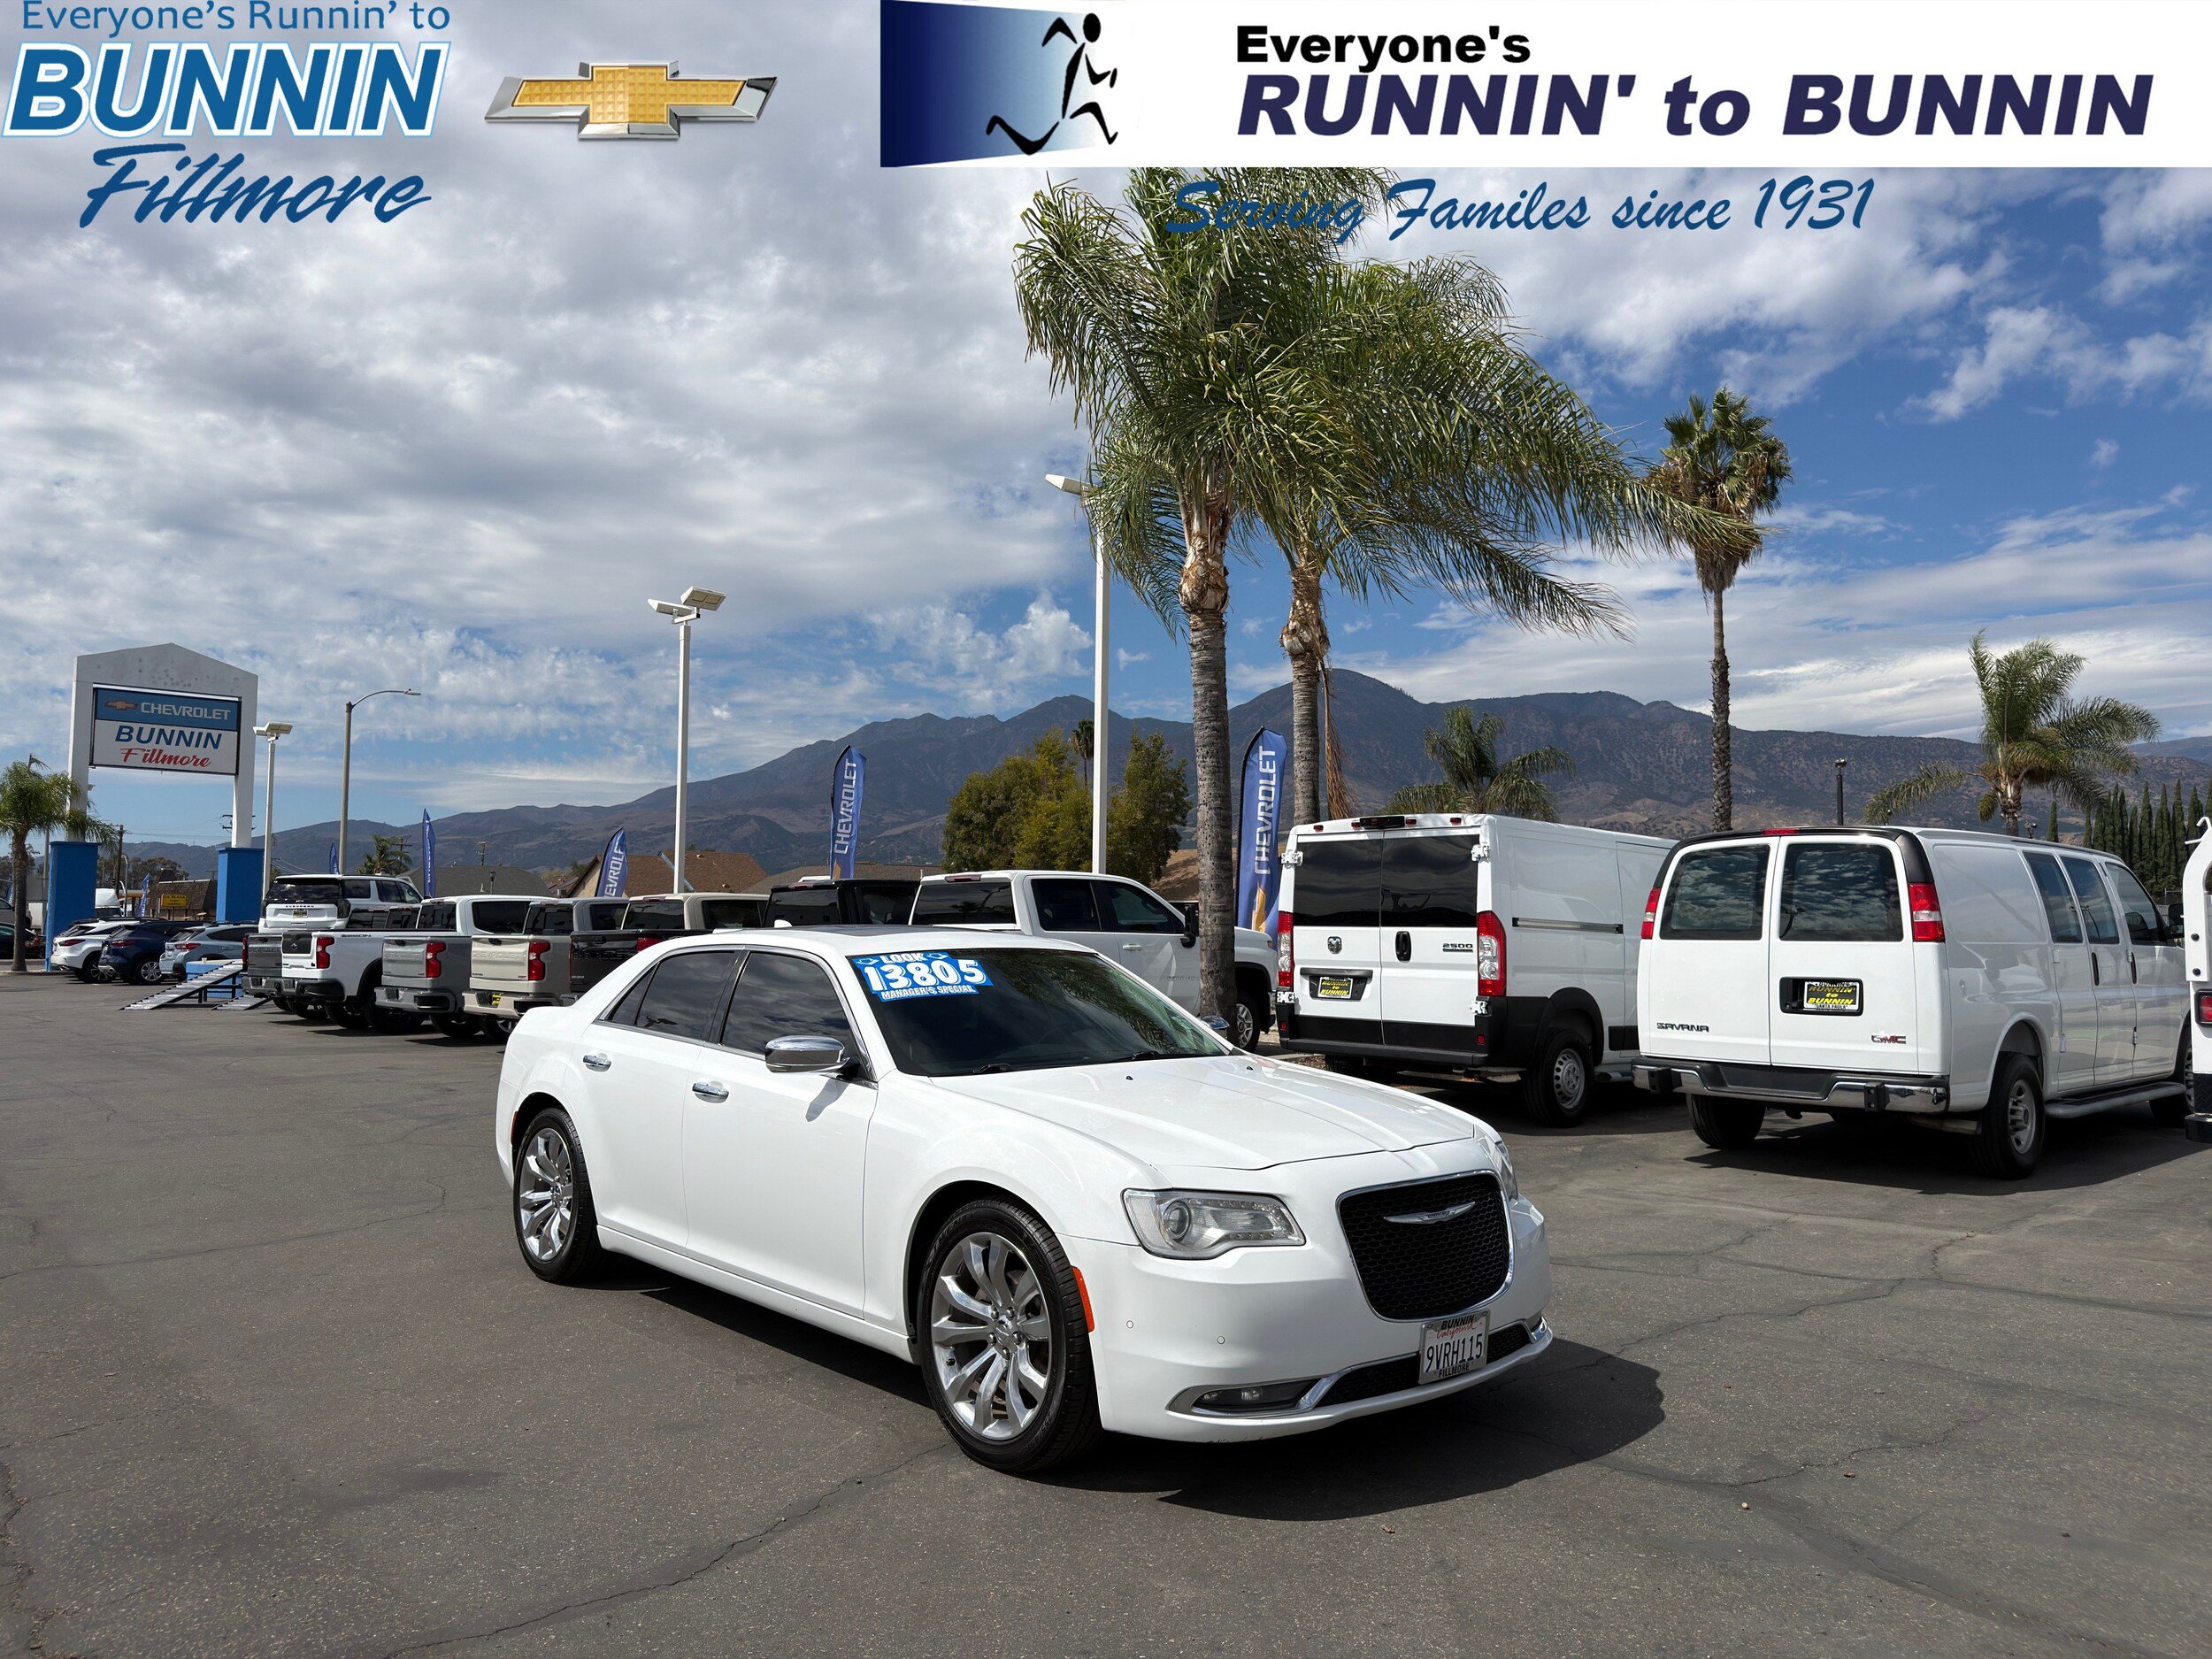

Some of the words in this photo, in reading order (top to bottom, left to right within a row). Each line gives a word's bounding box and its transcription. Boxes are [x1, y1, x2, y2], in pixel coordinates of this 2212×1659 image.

[141, 702, 231, 720] CHEVROLET
[115, 725, 222, 749] BUNNIN
[120, 748, 211, 768] Fillmore
[833, 758, 857, 855] CHEVROLET
[1254, 745, 1277, 875] CHEVROLET
[879, 952, 927, 964] LOOK
[864, 959, 987, 992] 13805
[880, 986, 936, 1000] MANAGER'S
[937, 984, 976, 995] SPECIAL
[1656, 1022, 1709, 1033] SAVANA
[1871, 1034, 1906, 1044] GMC
[1441, 1314, 1475, 1330] BUNNIN
[1436, 1324, 1477, 1339] California
[1425, 1333, 1483, 1372] 9VRH115
[1439, 1363, 1470, 1378] FILLMORE
